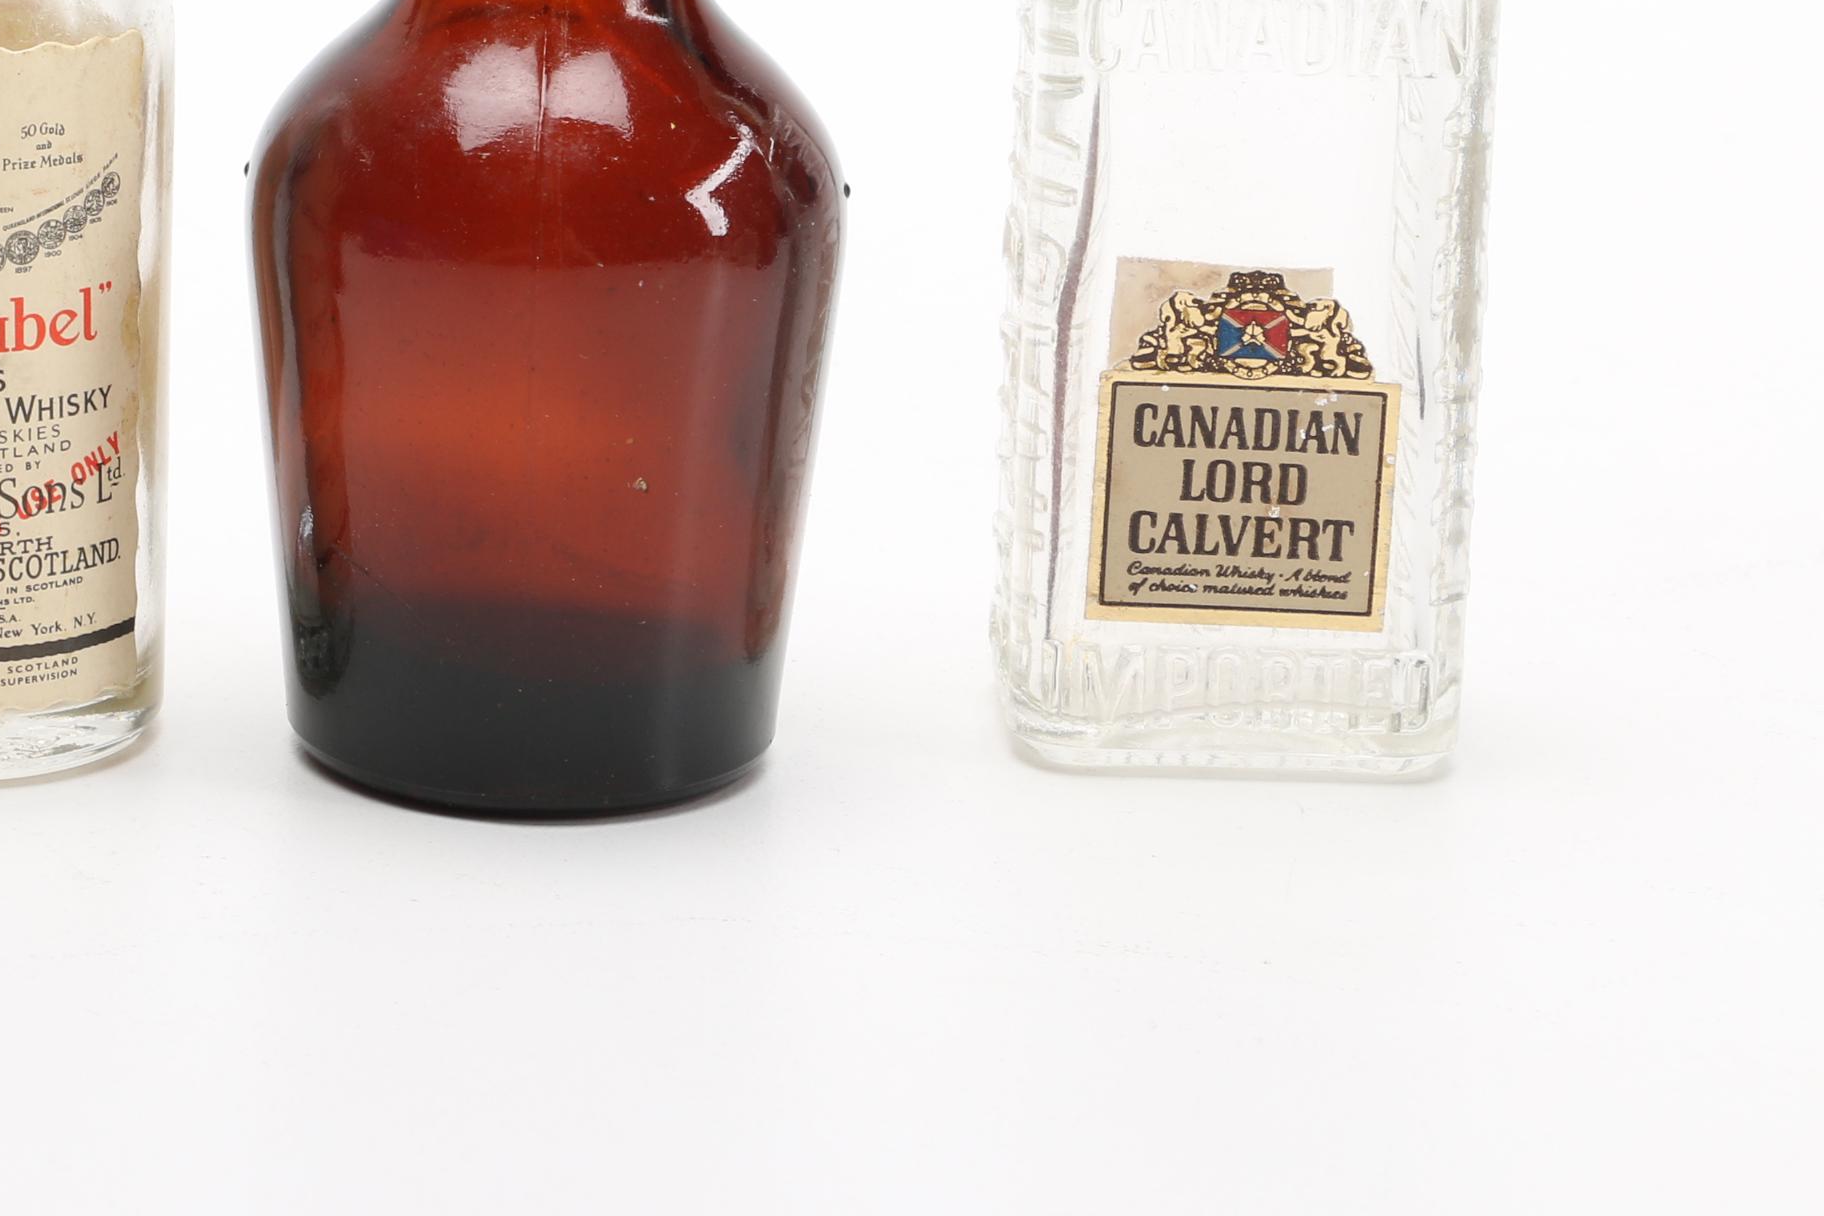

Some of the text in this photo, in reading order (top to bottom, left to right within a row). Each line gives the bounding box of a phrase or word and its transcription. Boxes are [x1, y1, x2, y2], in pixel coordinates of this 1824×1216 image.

[20, 122, 65, 139] 50 Gold
[36, 140, 52, 150] and
[2, 153, 83, 171] Prize Medals
[44, 249, 62, 258] 1900
[14, 265, 33, 274] 1897
[5, 384, 112, 425] WHISKY
[1132, 401, 1364, 457] CANADIAN
[16, 479, 62, 520] USE
[71, 431, 120, 485] ONLY
[25, 461, 41, 471] BY
[1178, 459, 1308, 506] LORD
[1128, 510, 1355, 562] CALVERT
[1126, 560, 1211, 578] Canadian
[1215, 564, 1275, 584] Whisky
[6, 587, 18, 595] IN
[25, 576, 83, 593] SCOTLAND
[1127, 577, 1148, 596] of
[13, 596, 35, 604] LTD.
[7, 656, 79, 674] SCOTLAND
[0, 668, 78, 687] SUPERVISION
[1040, 639, 1436, 734] IMPORTED
